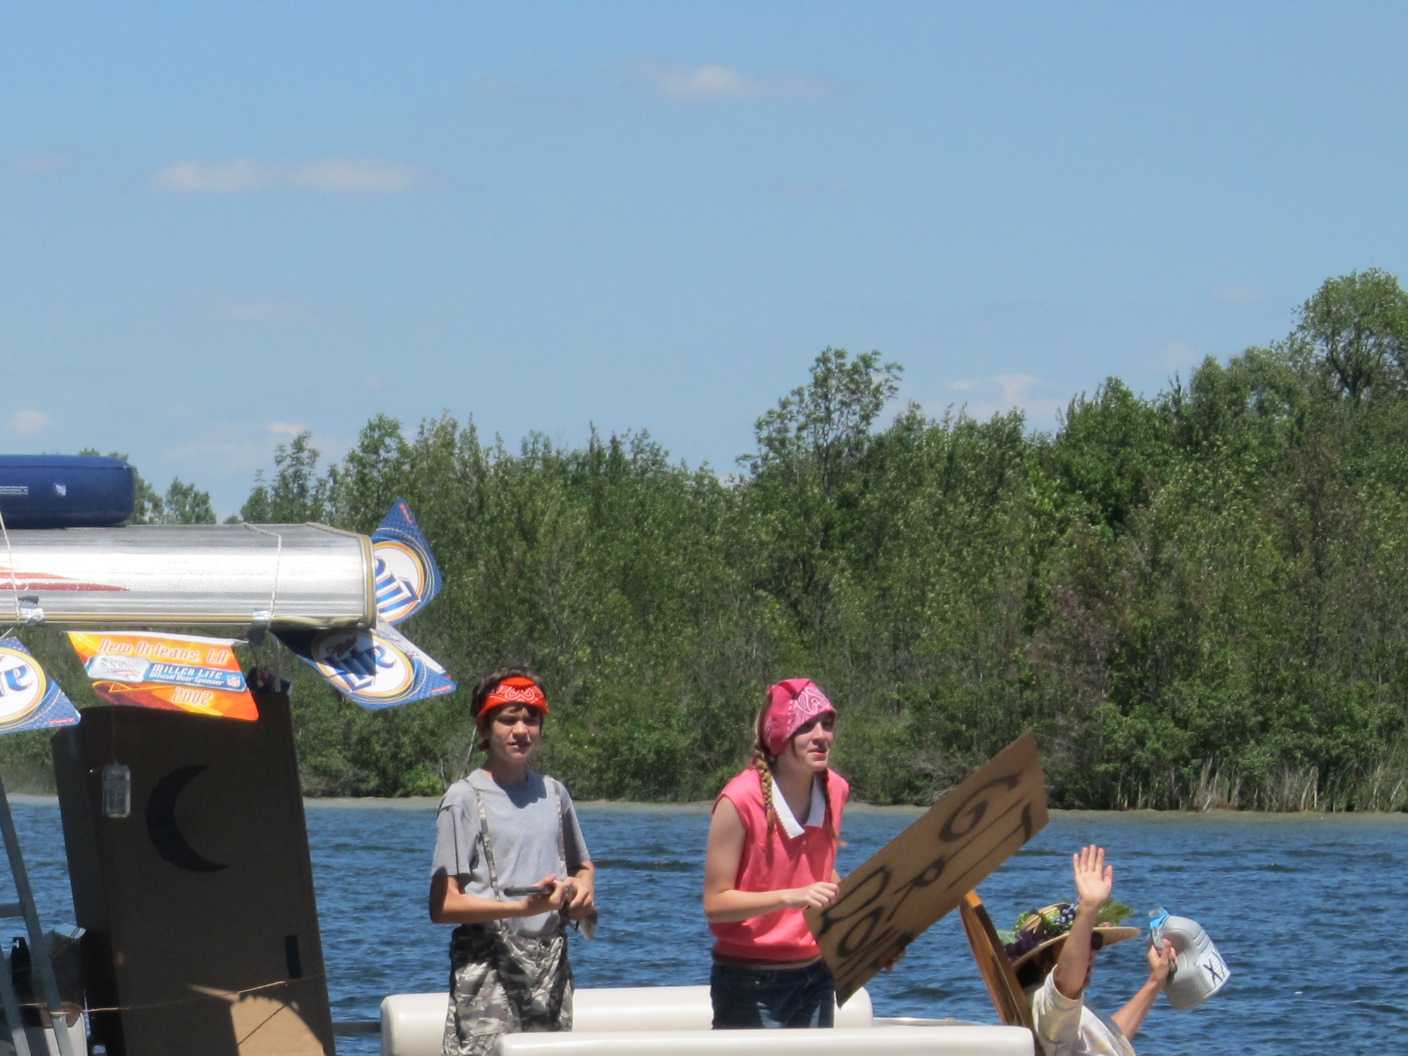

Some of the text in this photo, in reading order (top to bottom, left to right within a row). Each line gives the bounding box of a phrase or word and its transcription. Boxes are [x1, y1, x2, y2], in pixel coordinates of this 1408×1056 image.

[98, 638, 133, 654] New
[206, 648, 229, 665] LA
[322, 645, 395, 691] Lite
[194, 676, 225, 686] Sponsor
[171, 686, 214, 706] 2002
